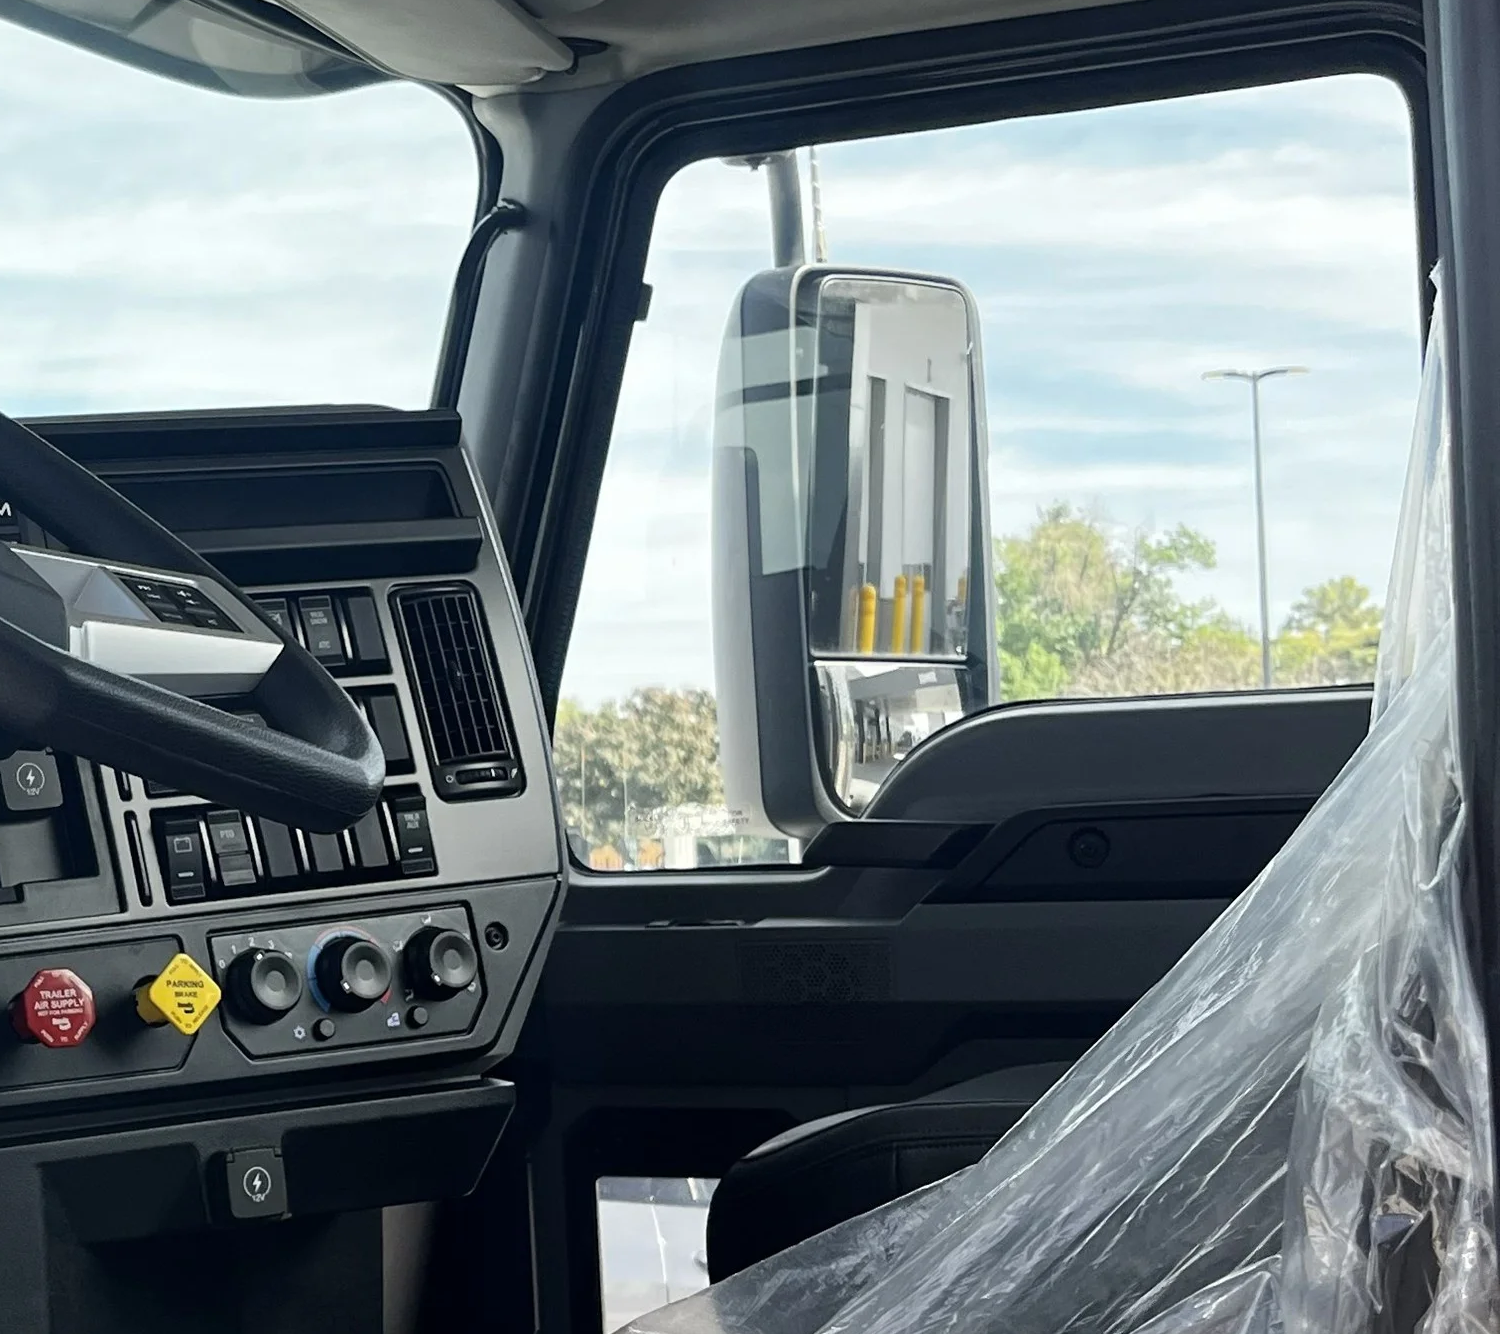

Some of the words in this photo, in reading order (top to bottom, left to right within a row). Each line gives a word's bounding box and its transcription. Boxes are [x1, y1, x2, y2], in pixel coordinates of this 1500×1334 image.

[26, 787, 40, 796] 12V
[220, 829, 235, 839] PTO
[231, 945, 237, 955] 1
[248, 937, 256, 947] 2
[268, 939, 275, 949] 3
[166, 980, 204, 989] PARKING
[40, 988, 77, 999] TRAILER
[34, 1001, 50, 1010] AIR
[50, 998, 84, 1009] SUPPLY
[252, 1193, 265, 1203] 12V
